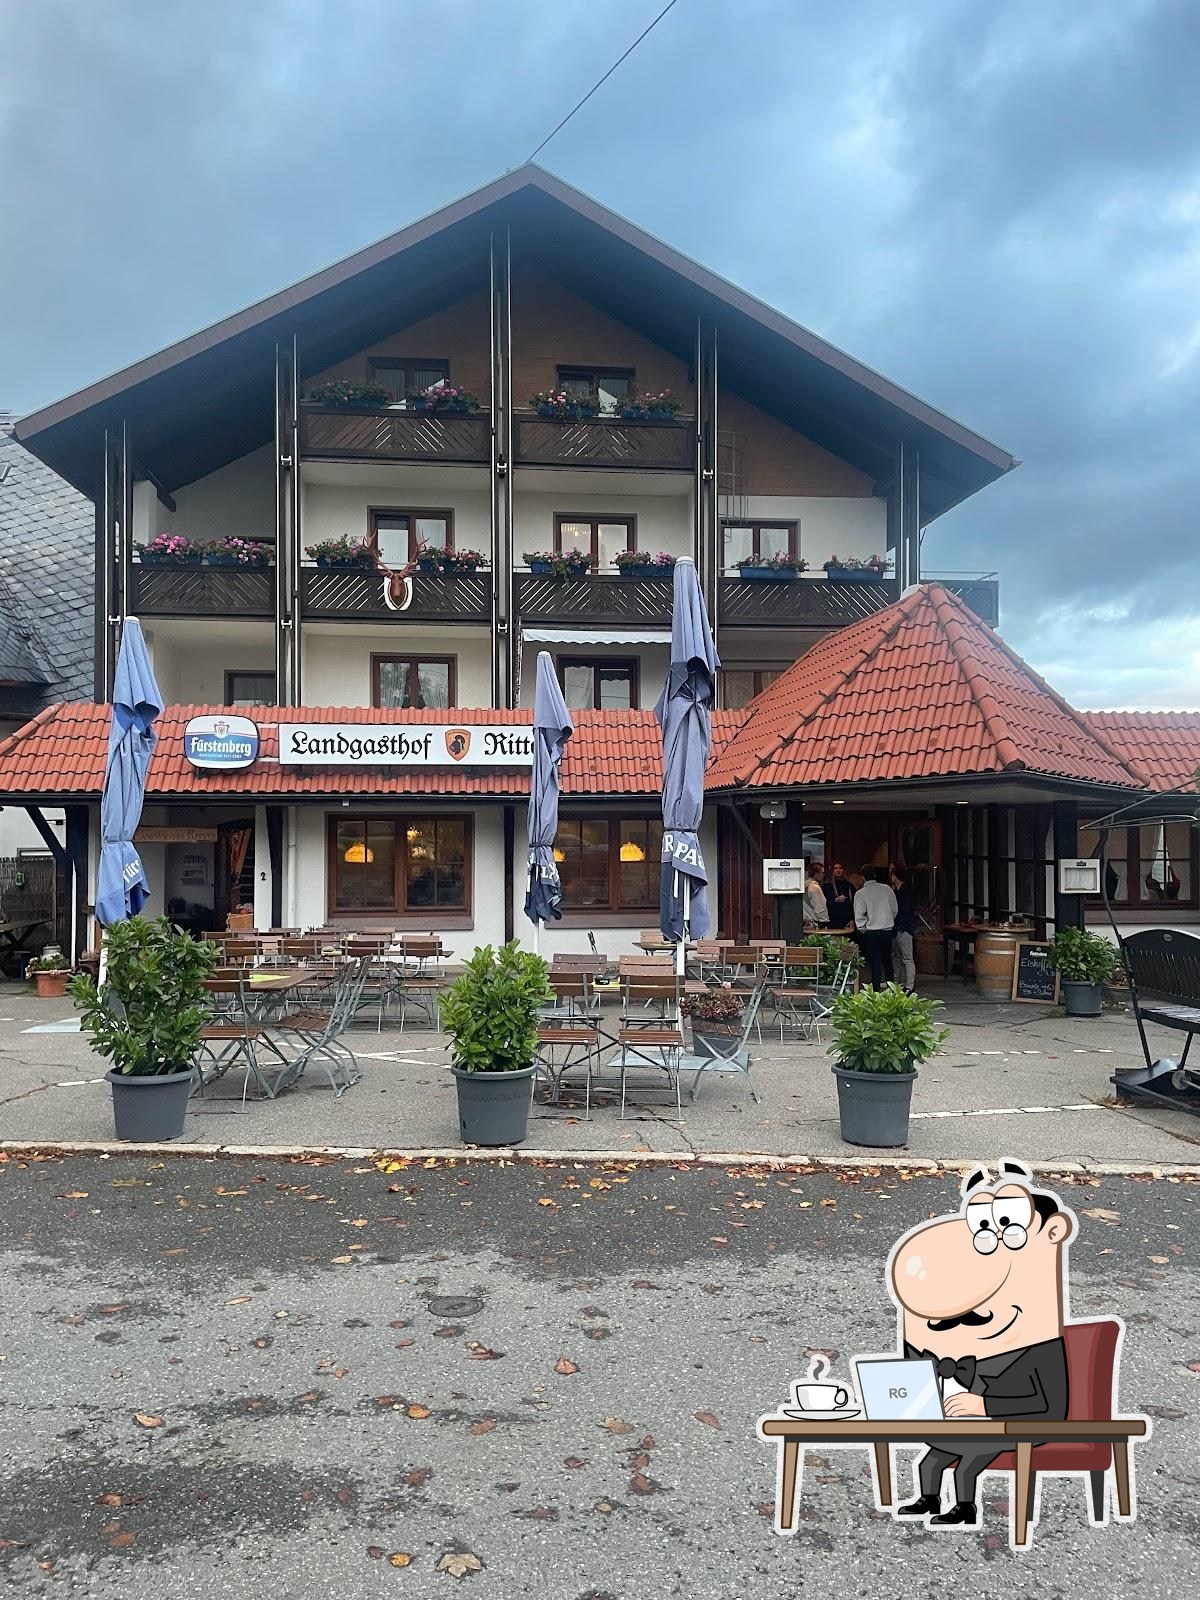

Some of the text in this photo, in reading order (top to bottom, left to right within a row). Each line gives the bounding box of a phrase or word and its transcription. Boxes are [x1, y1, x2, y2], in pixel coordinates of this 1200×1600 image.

[190, 736, 252, 757] Fürstenberg
[291, 731, 433, 760] Landgasthof
[260, 871, 267, 881] 2
